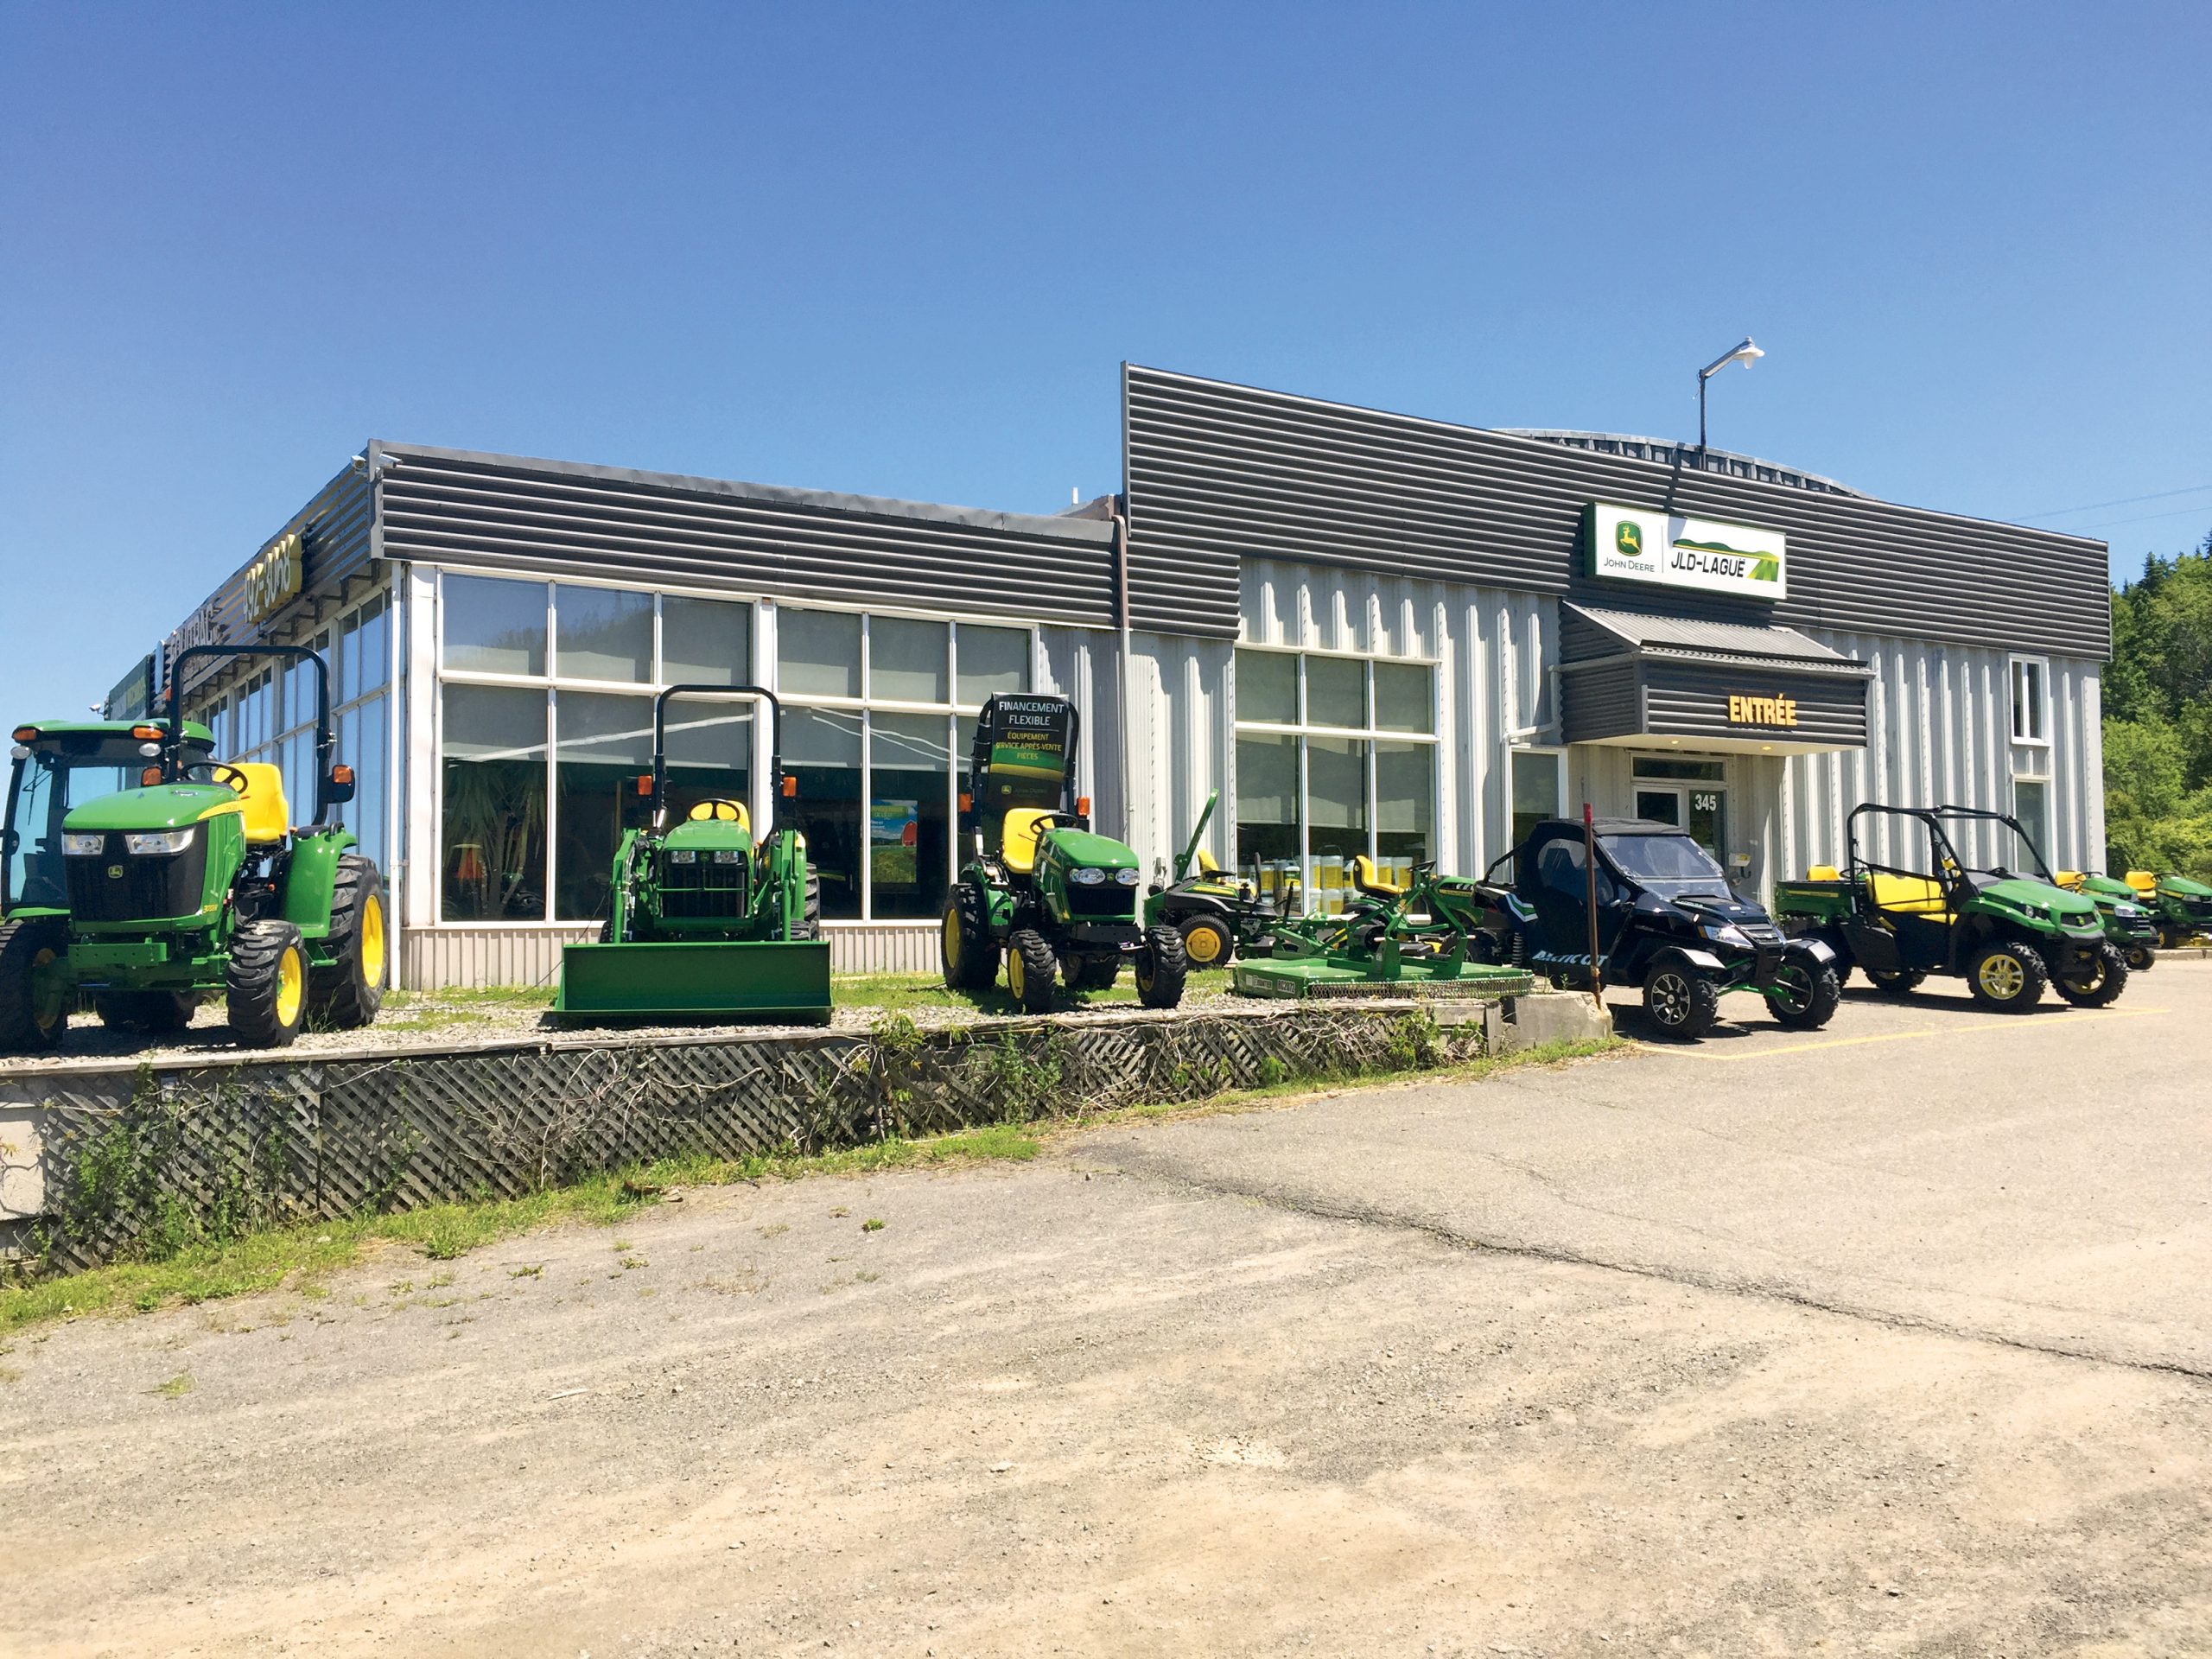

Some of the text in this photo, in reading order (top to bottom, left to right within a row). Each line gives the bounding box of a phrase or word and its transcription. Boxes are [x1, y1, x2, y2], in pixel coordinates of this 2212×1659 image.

[1604, 557, 1656, 573] JOHN DEERE
[999, 701, 1065, 714] FINANCEMENT
[1729, 693, 1798, 727] ENTRÉE
[1008, 715, 1051, 726] FLEXIBLE
[1007, 731, 1050, 741] ÉQUIPEMENT
[1694, 794, 1717, 811] 345
